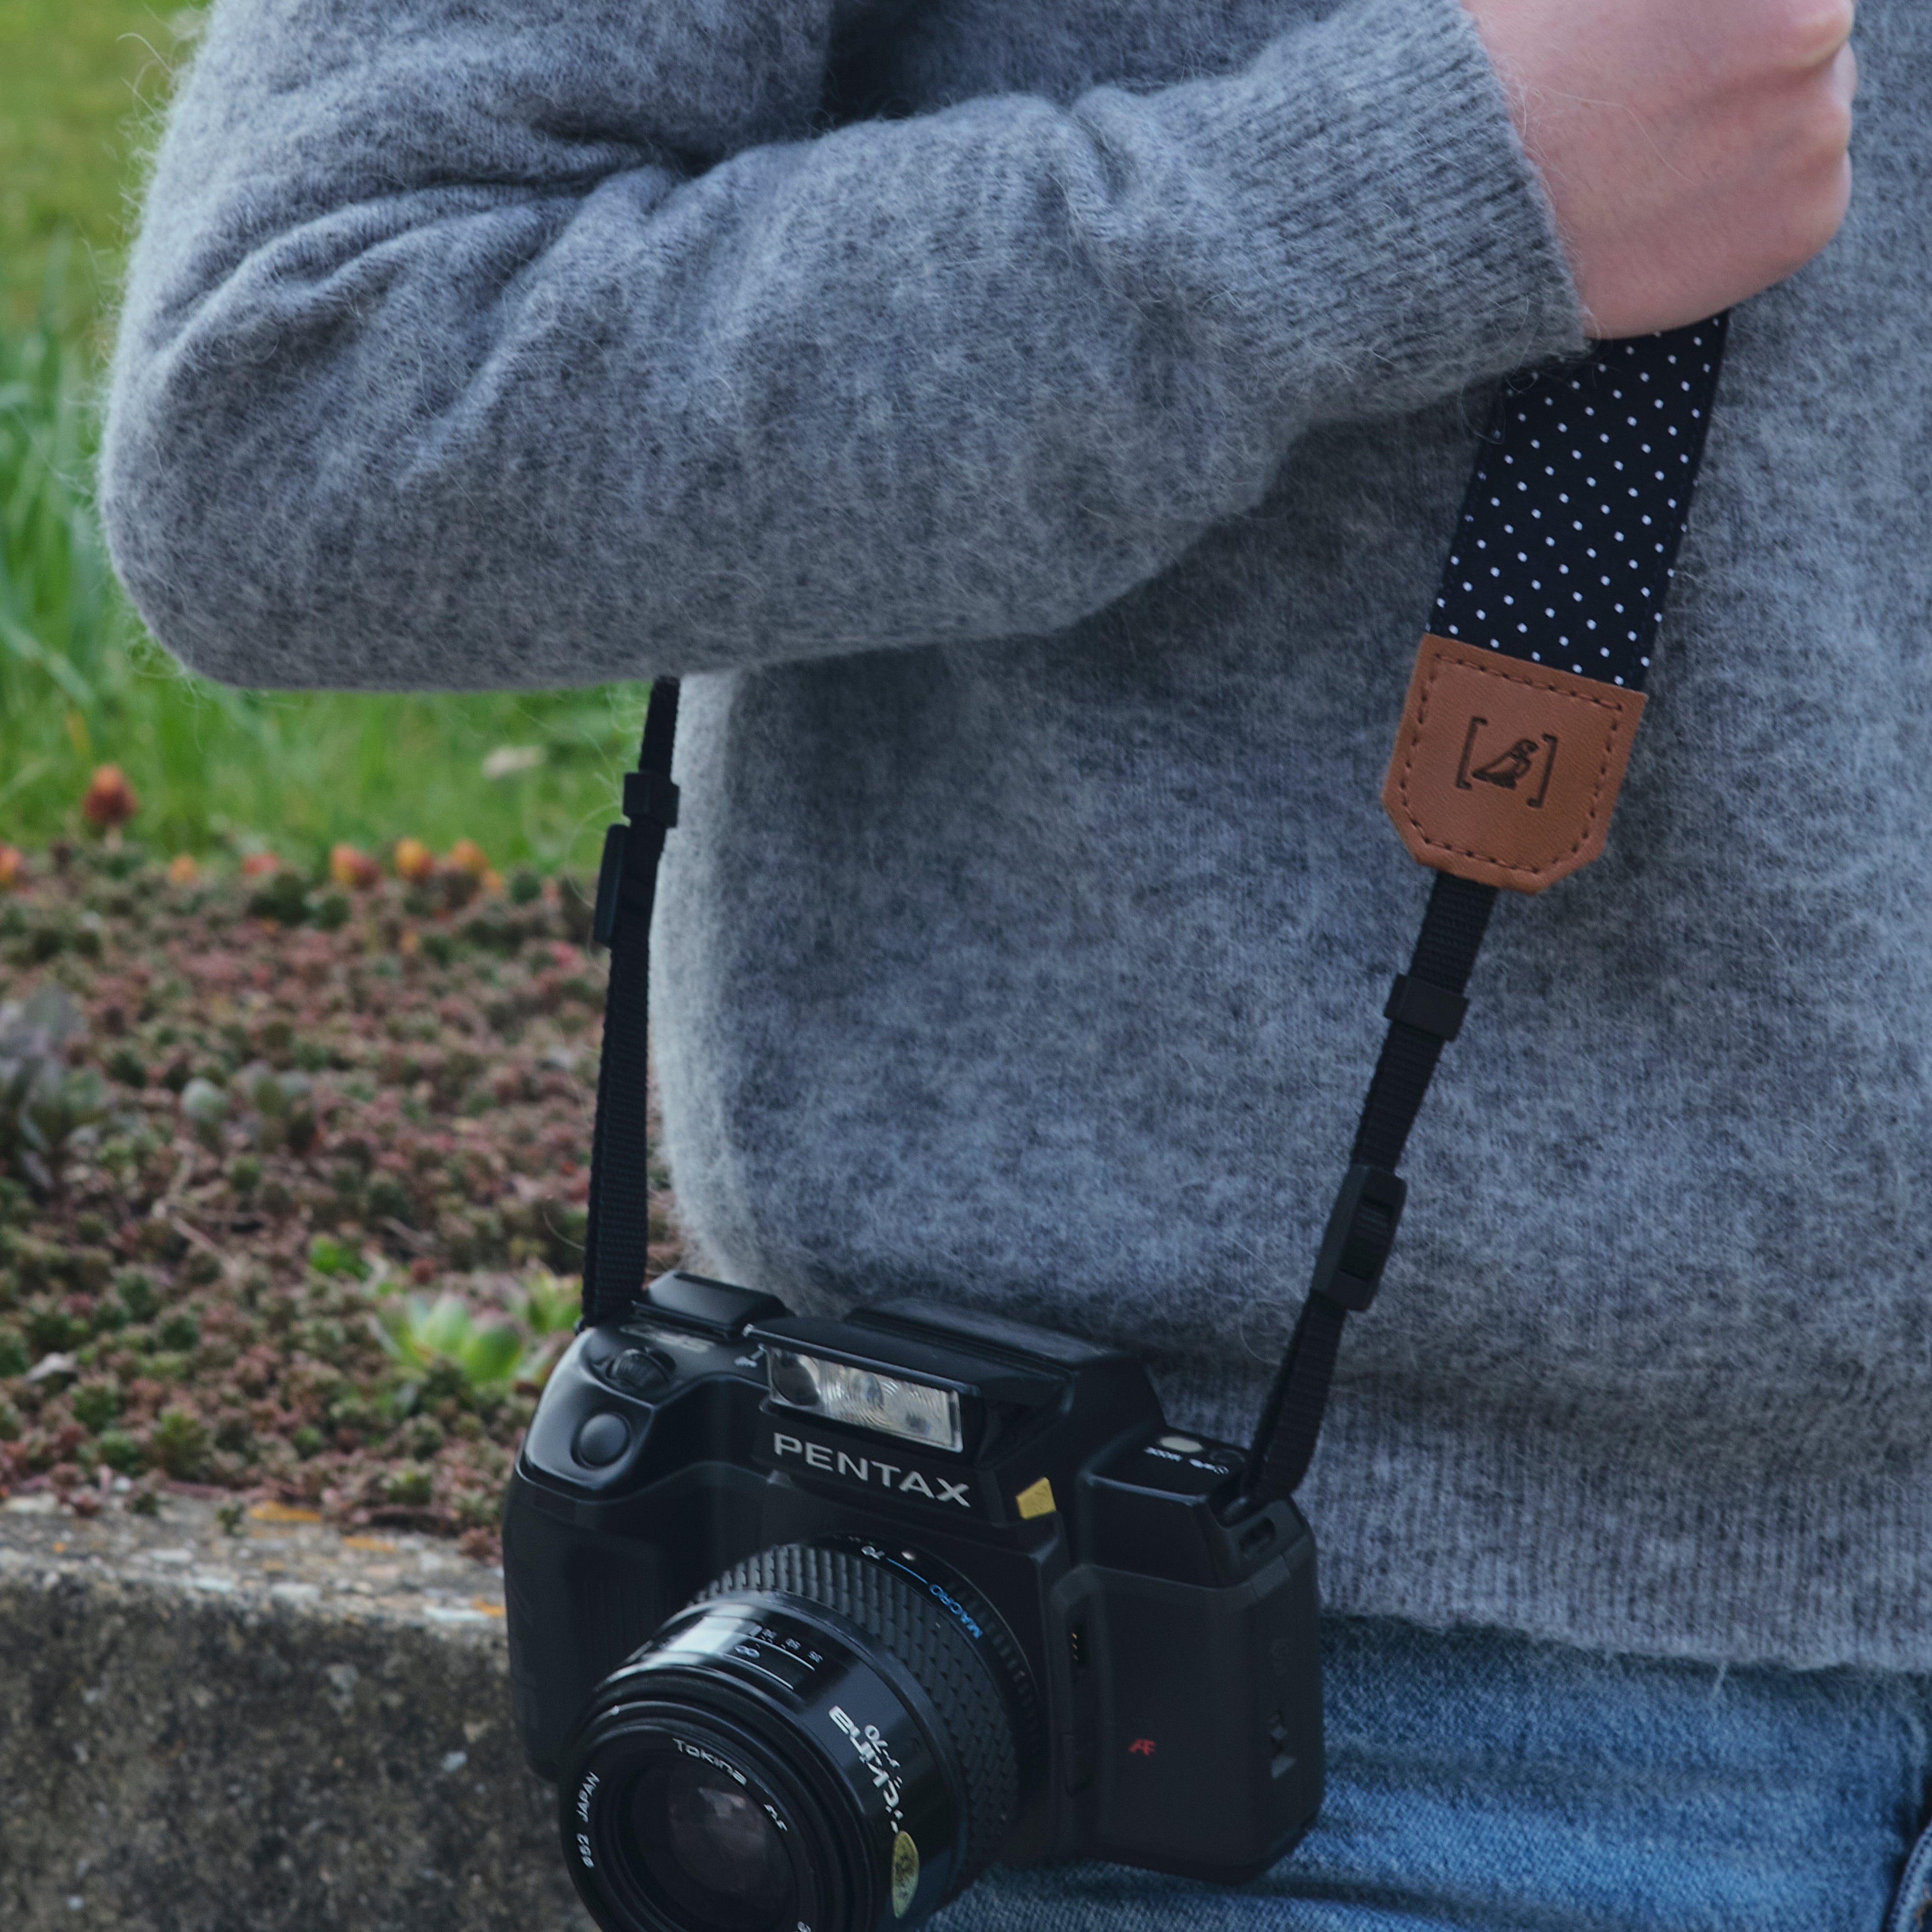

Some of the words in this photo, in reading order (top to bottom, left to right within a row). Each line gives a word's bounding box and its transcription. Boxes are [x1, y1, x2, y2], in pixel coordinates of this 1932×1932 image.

[773, 1432, 971, 1508] PENTAX
[928, 1583, 983, 1640] MACRO
[671, 1737, 747, 1786] Tokina
[576, 1770, 601, 1823] JAPAN
